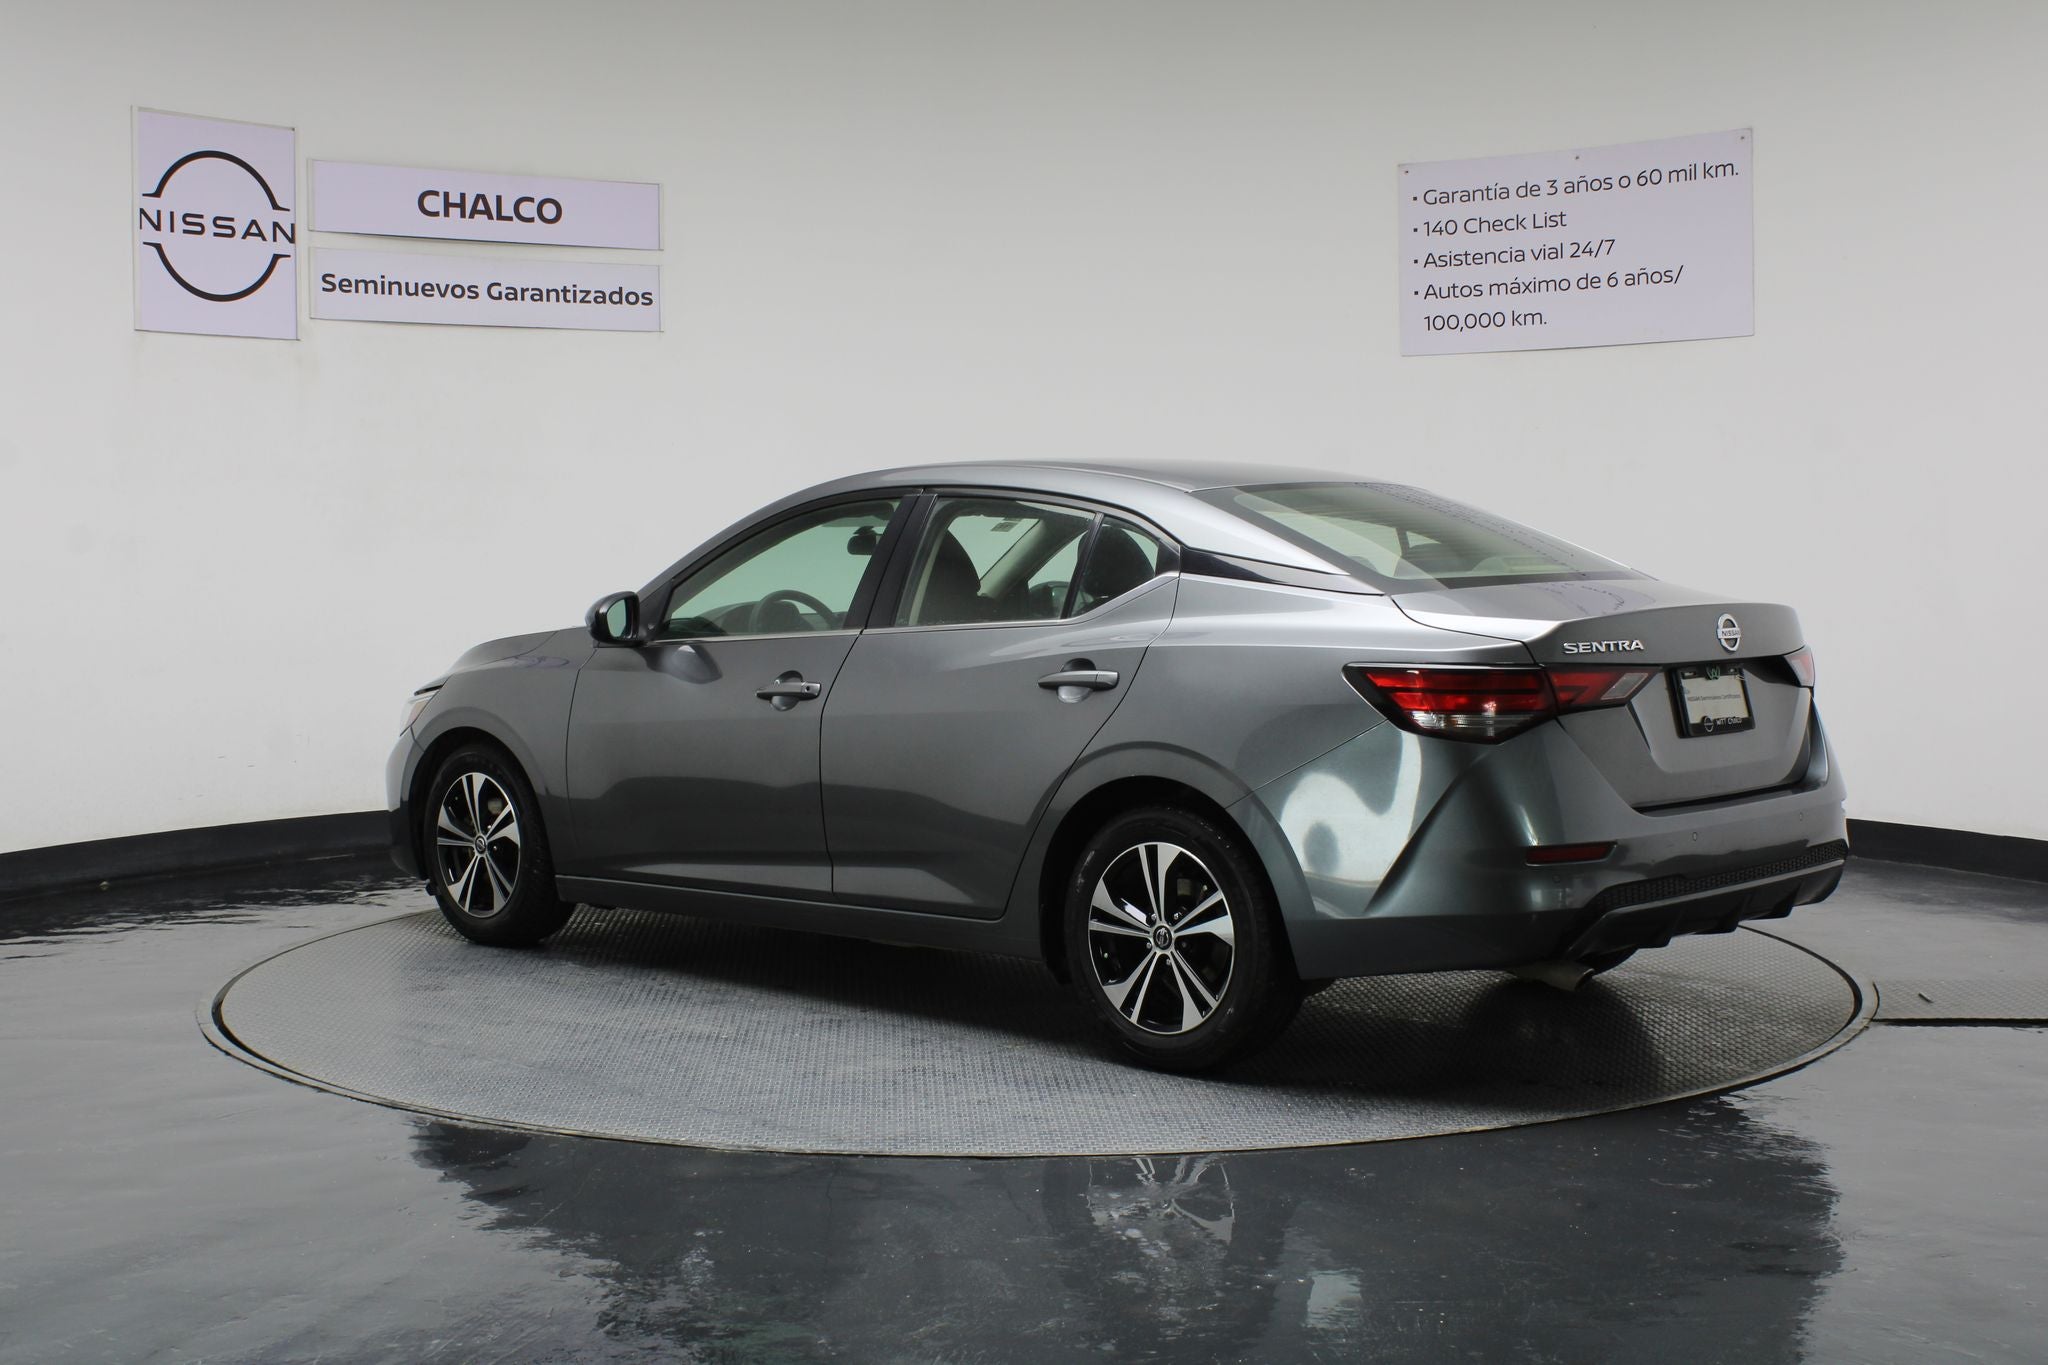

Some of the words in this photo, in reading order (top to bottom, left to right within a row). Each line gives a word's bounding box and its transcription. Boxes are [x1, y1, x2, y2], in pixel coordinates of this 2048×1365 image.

[1423, 182, 1510, 206] Garantía
[1516, 180, 1541, 199] de
[1547, 179, 1559, 196] 3
[1563, 175, 1614, 195] años
[1618, 175, 1631, 189] o
[1636, 168, 1663, 187] 60
[1668, 162, 1697, 184] mil
[1703, 161, 1740, 180] km.
[418, 189, 563, 225] CHALCO
[1423, 219, 1458, 237] 140
[1463, 213, 1527, 234] Check
[1532, 211, 1568, 230] List
[139, 207, 296, 245] NISSAN
[1423, 246, 1526, 269] Asistencia
[1530, 242, 1564, 261] vial
[1569, 239, 1616, 259] 24/7
[321, 272, 480, 300] Seminuevos
[486, 281, 654, 307] Garantizados
[1423, 282, 1484, 300] Autos
[1488, 276, 1571, 297] máximo
[1576, 272, 1602, 291] de
[1606, 271, 1619, 288] 6
[1624, 264, 1684, 287] años/
[1423, 311, 1506, 333] 100,000
[1511, 309, 1548, 327] km.
[1563, 639, 1644, 654] SENTRA
